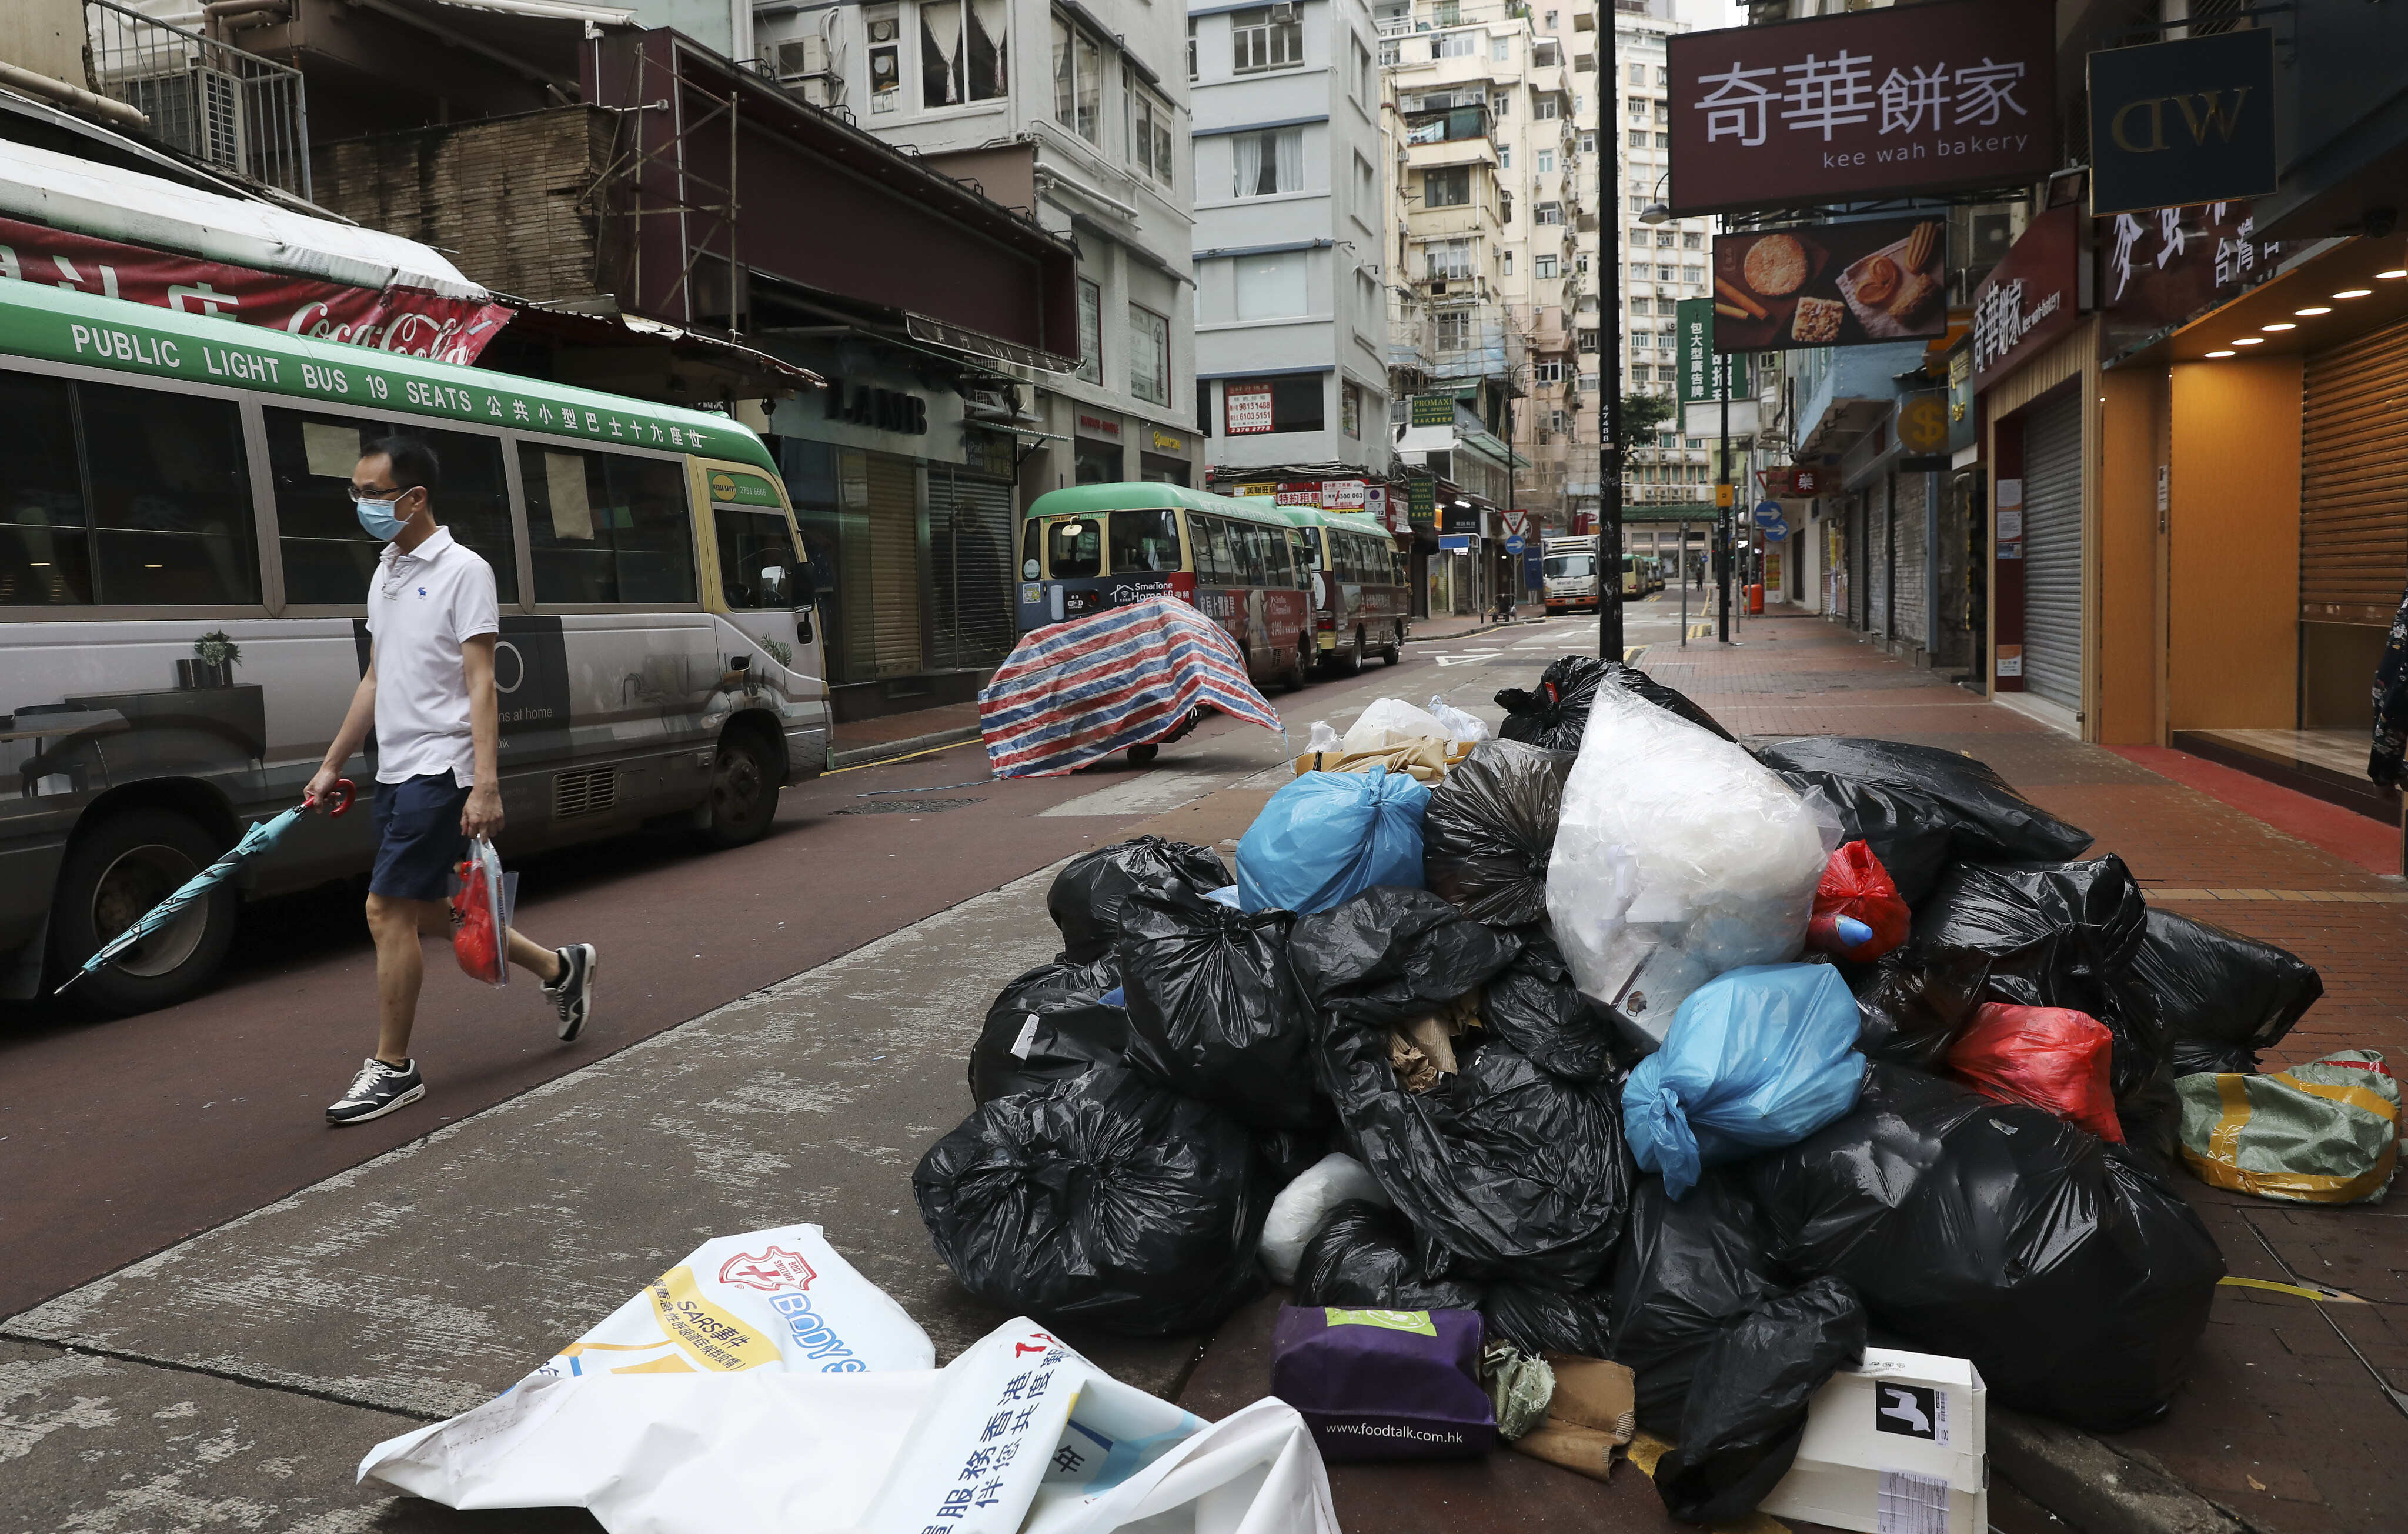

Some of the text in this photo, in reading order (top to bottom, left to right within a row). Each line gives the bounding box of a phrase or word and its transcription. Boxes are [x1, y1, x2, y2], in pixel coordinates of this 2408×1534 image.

[1694, 49, 2028, 147] 奇華餅家
[1823, 133, 2028, 169] kee wah bakery
[71, 324, 472, 412] PUBLIC LIGHT BUS 19 SEATS
[1690, 322, 1704, 398] 包大型廣告牌
[1414, 398, 1452, 407] PROMAXI
[486, 395, 702, 449] 公共小型巴士十九座位
[740, 486, 752, 495] 2751
[1279, 492, 1320, 504] 特約租售
[1135, 582, 1173, 591] SmarTone
[513, 709, 523, 722] at
[526, 706, 553, 721] home
[774, 1260, 795, 1282] SHIELDER
[788, 1262, 803, 1275] BODY
[677, 1300, 751, 1349] SARS事件
[769, 1293, 853, 1360] BODY
[1326, 1421, 1464, 1445] www.foodtalk.com.hk
